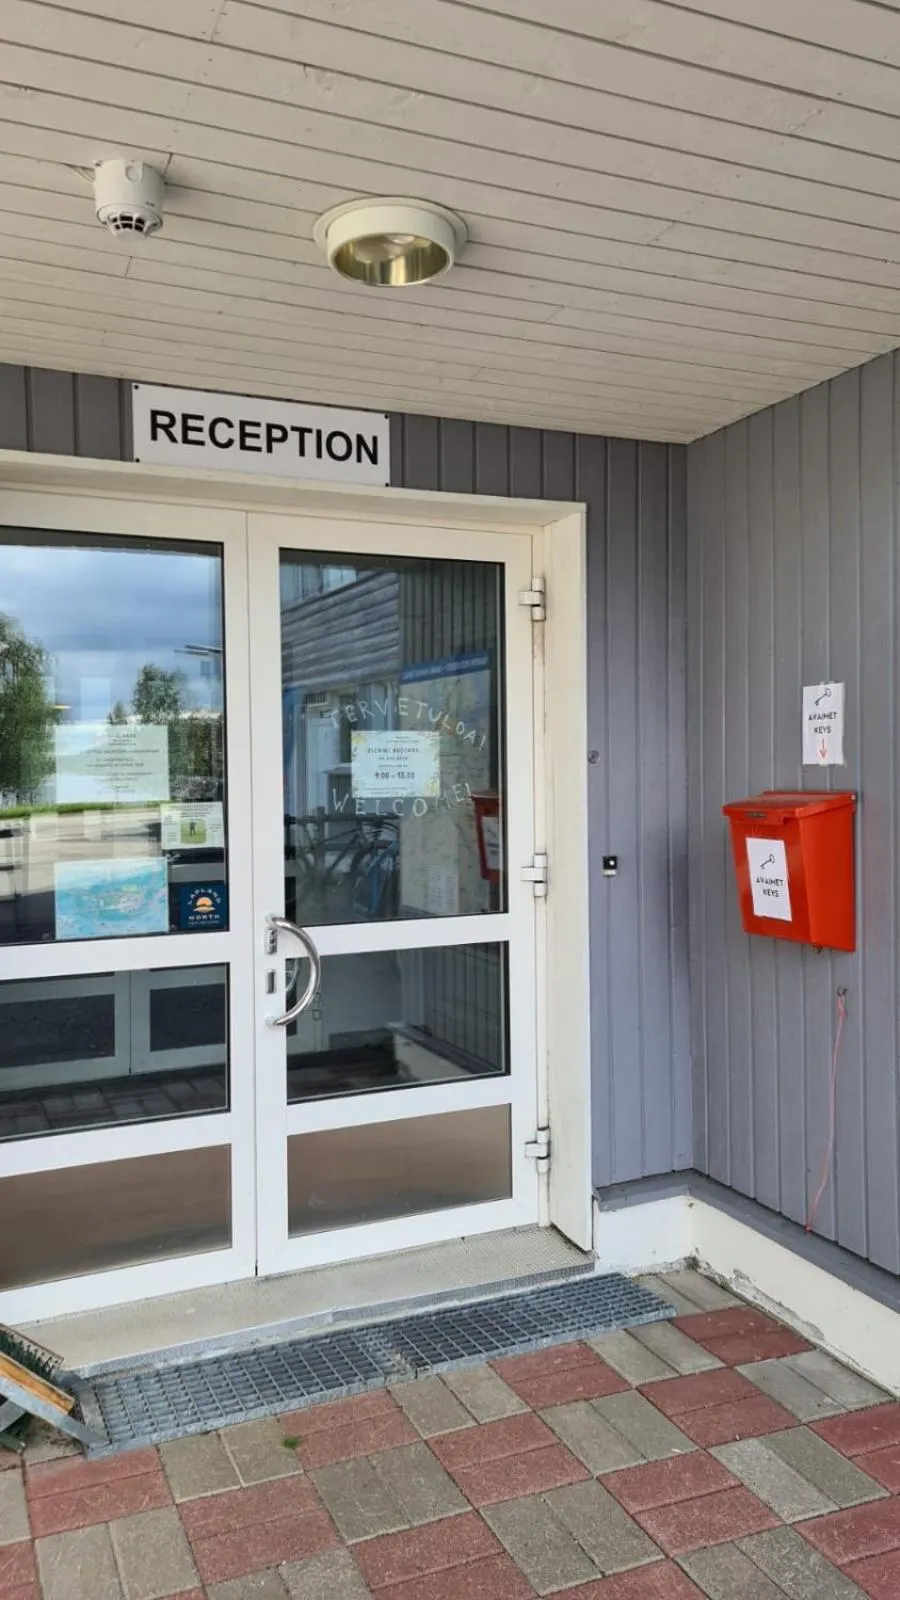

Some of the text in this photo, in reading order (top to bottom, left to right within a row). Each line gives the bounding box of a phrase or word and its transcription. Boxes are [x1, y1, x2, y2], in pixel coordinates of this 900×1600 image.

[149, 408, 379, 466] RECEPTION
[808, 712, 837, 721] AVAIMET
[324, 697, 487, 752] TERVETULOA!
[814, 726, 832, 734] KEYS
[333, 783, 472, 817] WELCOME!
[755, 874, 784, 887] AVAIMET
[187, 888, 222, 905] LAPLAND
[762, 889, 780, 898] KEYS
